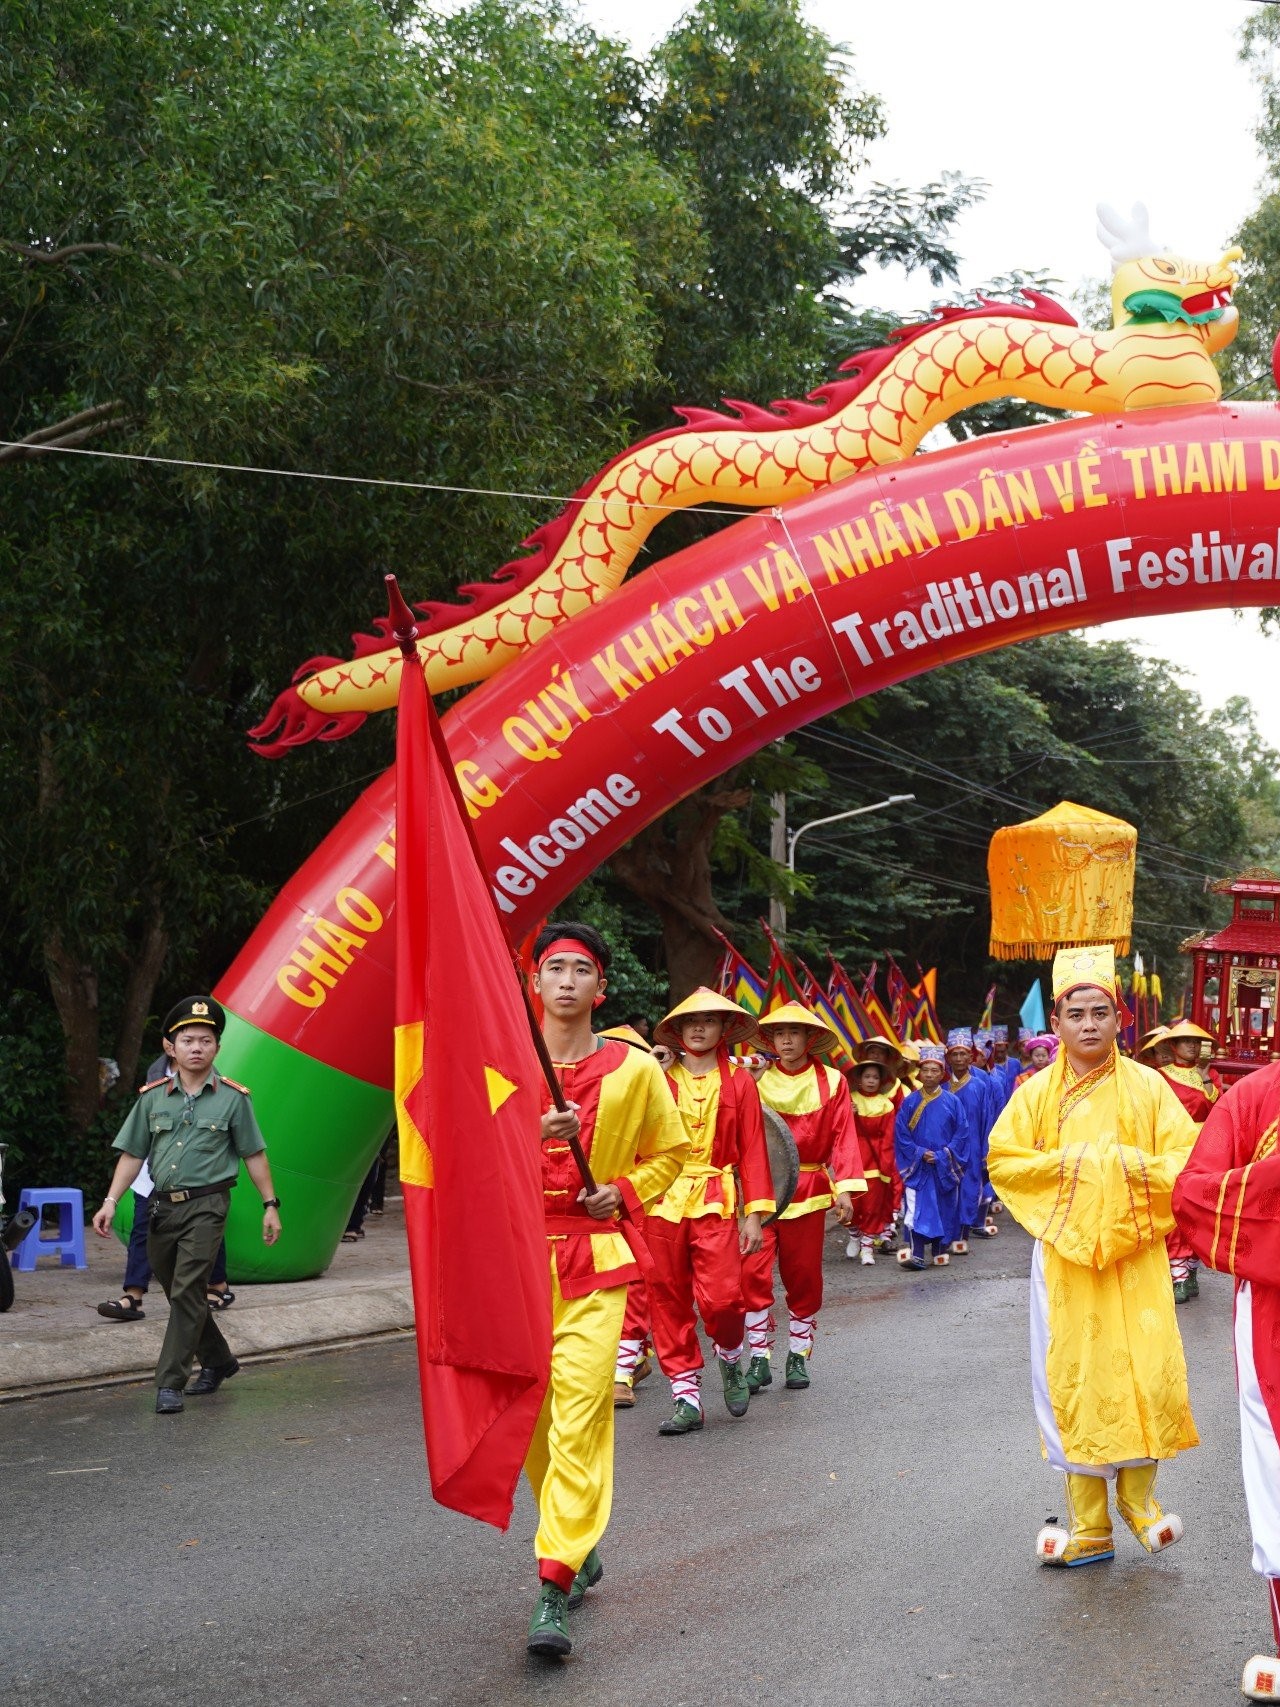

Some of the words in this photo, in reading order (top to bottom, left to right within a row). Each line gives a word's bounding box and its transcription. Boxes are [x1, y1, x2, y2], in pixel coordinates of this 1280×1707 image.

[275, 885, 384, 1008] CHÀO
[502, 664, 593, 762] QUÝ
[592, 578, 746, 702] KHÁCH
[742, 541, 814, 613] VÀ
[813, 500, 941, 586] NHÂN
[943, 469, 1044, 542] DÂN
[1046, 439, 1109, 514] VỀ
[1122, 440, 1248, 501] THAM
[652, 706, 732, 758] To
[719, 656, 822, 717] The
[832, 548, 1088, 667] Traditional
